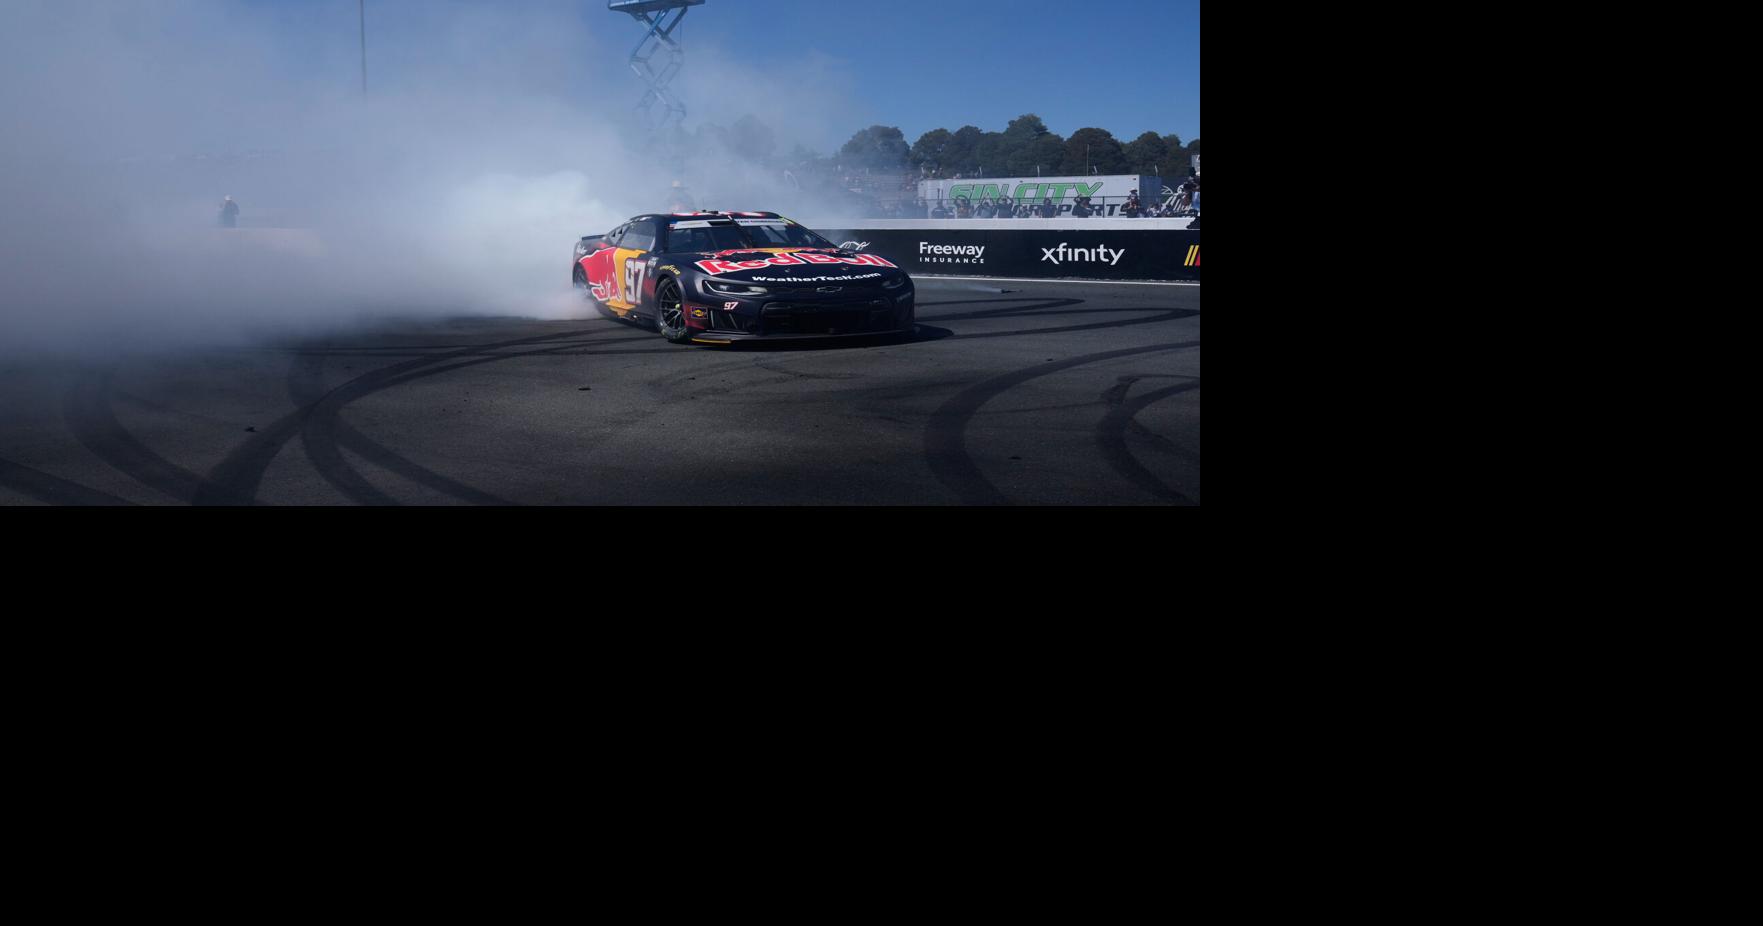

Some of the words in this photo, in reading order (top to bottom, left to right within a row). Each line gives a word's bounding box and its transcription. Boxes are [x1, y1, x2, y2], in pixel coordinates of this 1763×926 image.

[949, 183, 1009, 205] SIN
[1012, 182, 1103, 205] CITY
[919, 241, 985, 258] Freeway
[1041, 242, 1126, 266] xfinity
[694, 252, 807, 275] Red
[796, 253, 899, 269] Bull
[625, 258, 647, 304] 97
[723, 301, 739, 311] 97
